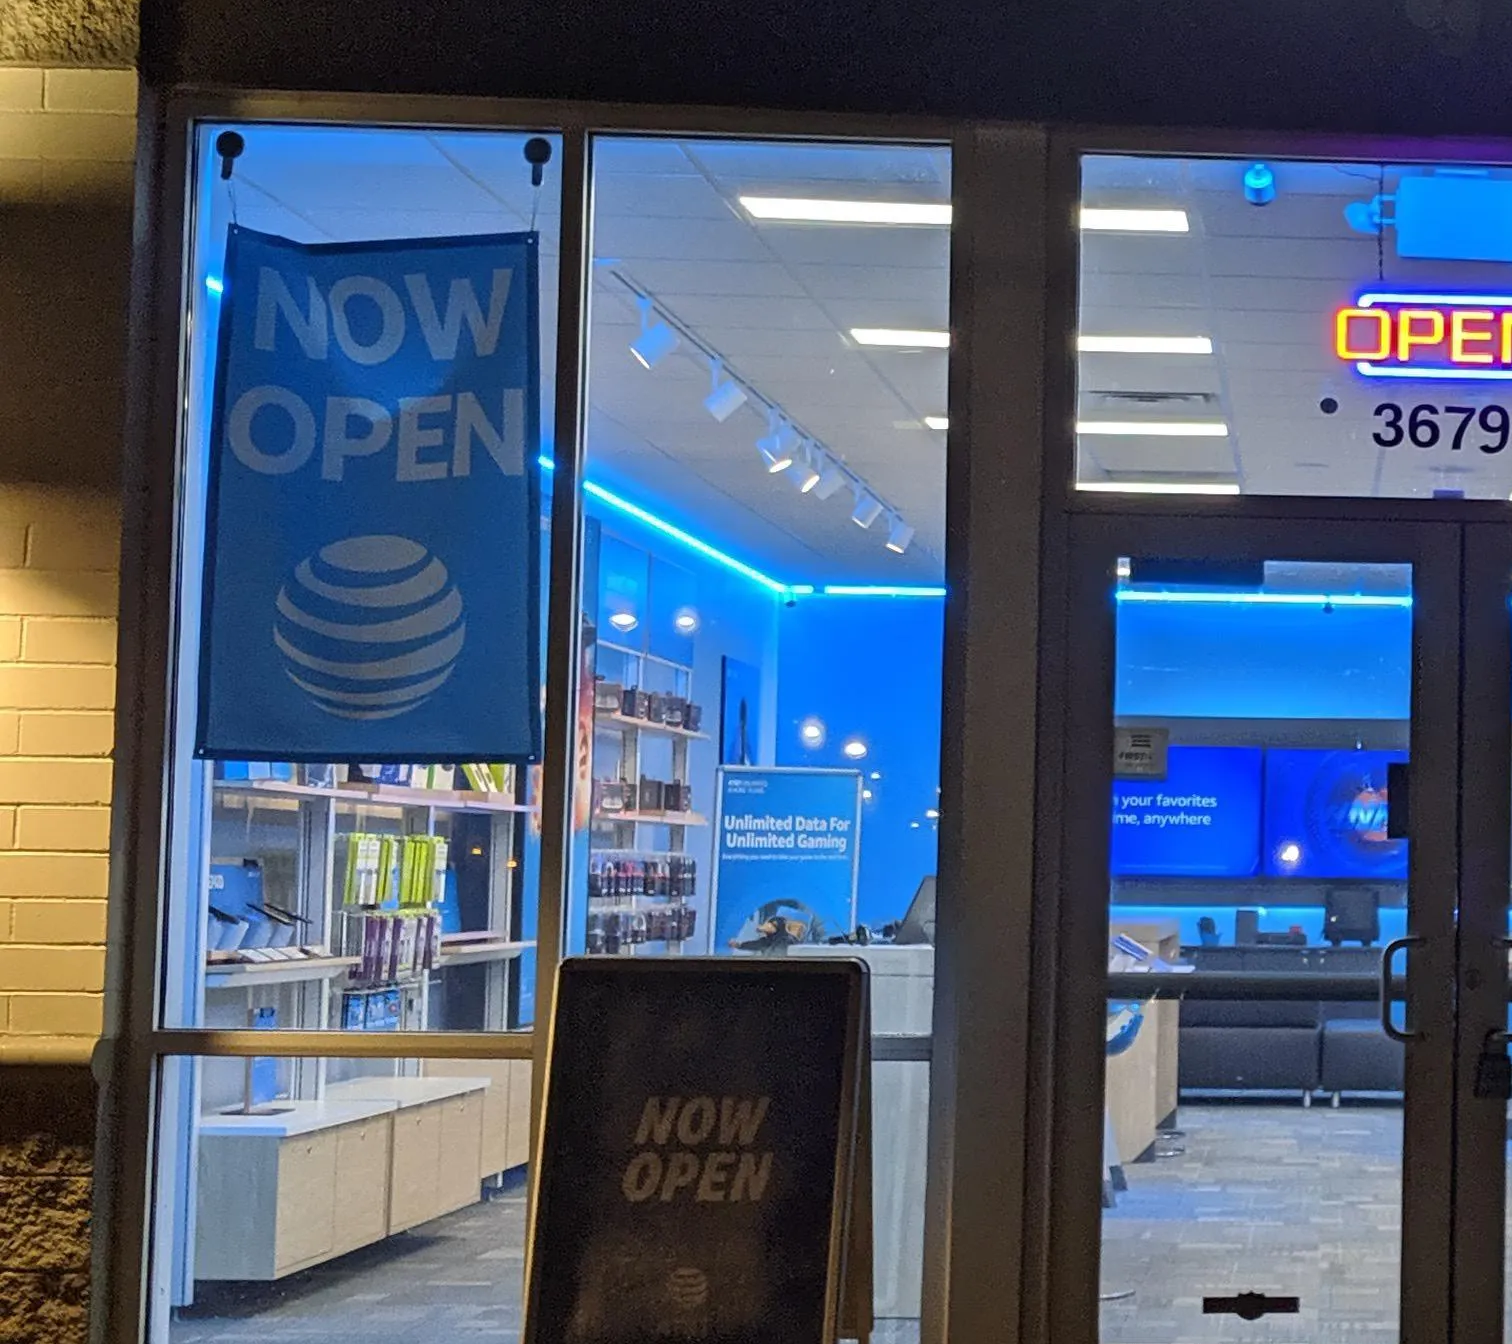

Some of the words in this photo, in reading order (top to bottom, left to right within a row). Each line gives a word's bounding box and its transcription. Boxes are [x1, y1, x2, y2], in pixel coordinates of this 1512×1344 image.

[254, 265, 513, 365] NOW
[228, 384, 525, 483] OPEN
[1122, 795, 1154, 810] your
[1155, 793, 1218, 809] favorites
[724, 814, 793, 831] Unlimited
[795, 815, 828, 832] Data
[829, 816, 852, 832] For
[1143, 811, 1213, 829] anywhere
[726, 832, 795, 849] Unlimited
[797, 833, 848, 853] Gaming
[633, 1094, 771, 1146] NOW
[621, 1151, 775, 1203] OPEN
